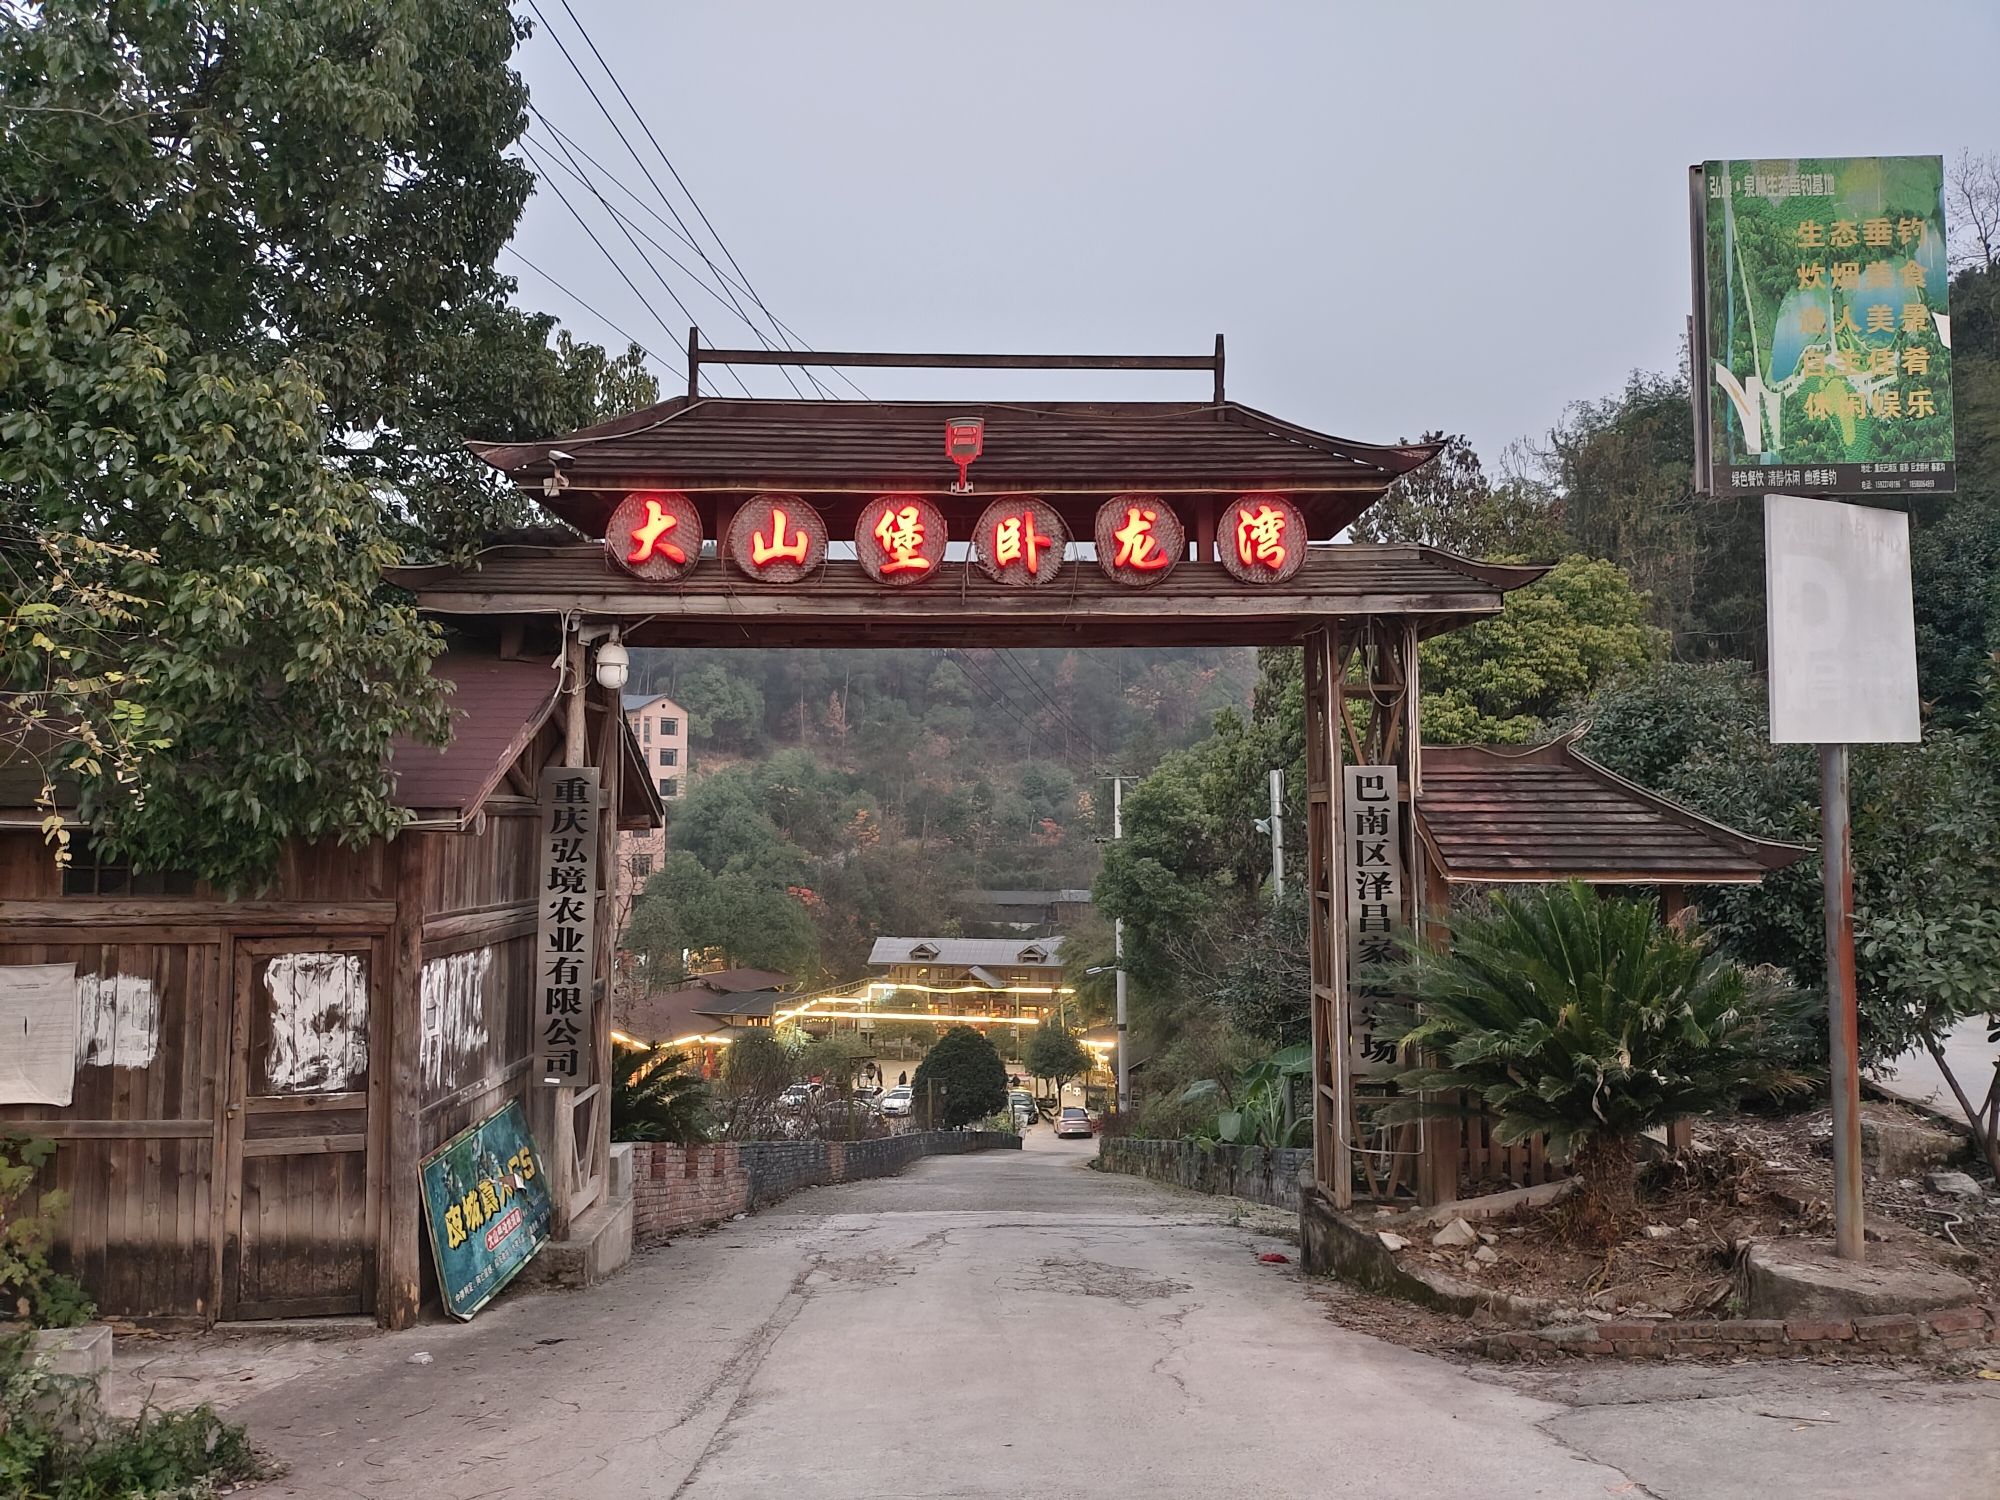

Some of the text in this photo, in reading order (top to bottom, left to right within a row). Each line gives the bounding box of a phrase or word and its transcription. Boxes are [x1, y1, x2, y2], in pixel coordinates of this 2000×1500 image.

[1797, 216, 1927, 248] 生态垂钓
[1796, 259, 1929, 290] 炊烟美食
[1802, 346, 1932, 377] 自主佳肴
[1803, 387, 1936, 421] 休闲娱乐
[1731, 470, 1765, 488] 绿色餐饮
[1804, 468, 1837, 486] 幽雅垂钓
[631, 499, 1288, 575] 大山堡卧龙湾
[543, 775, 591, 1079] 重庆弘境农业有限公司
